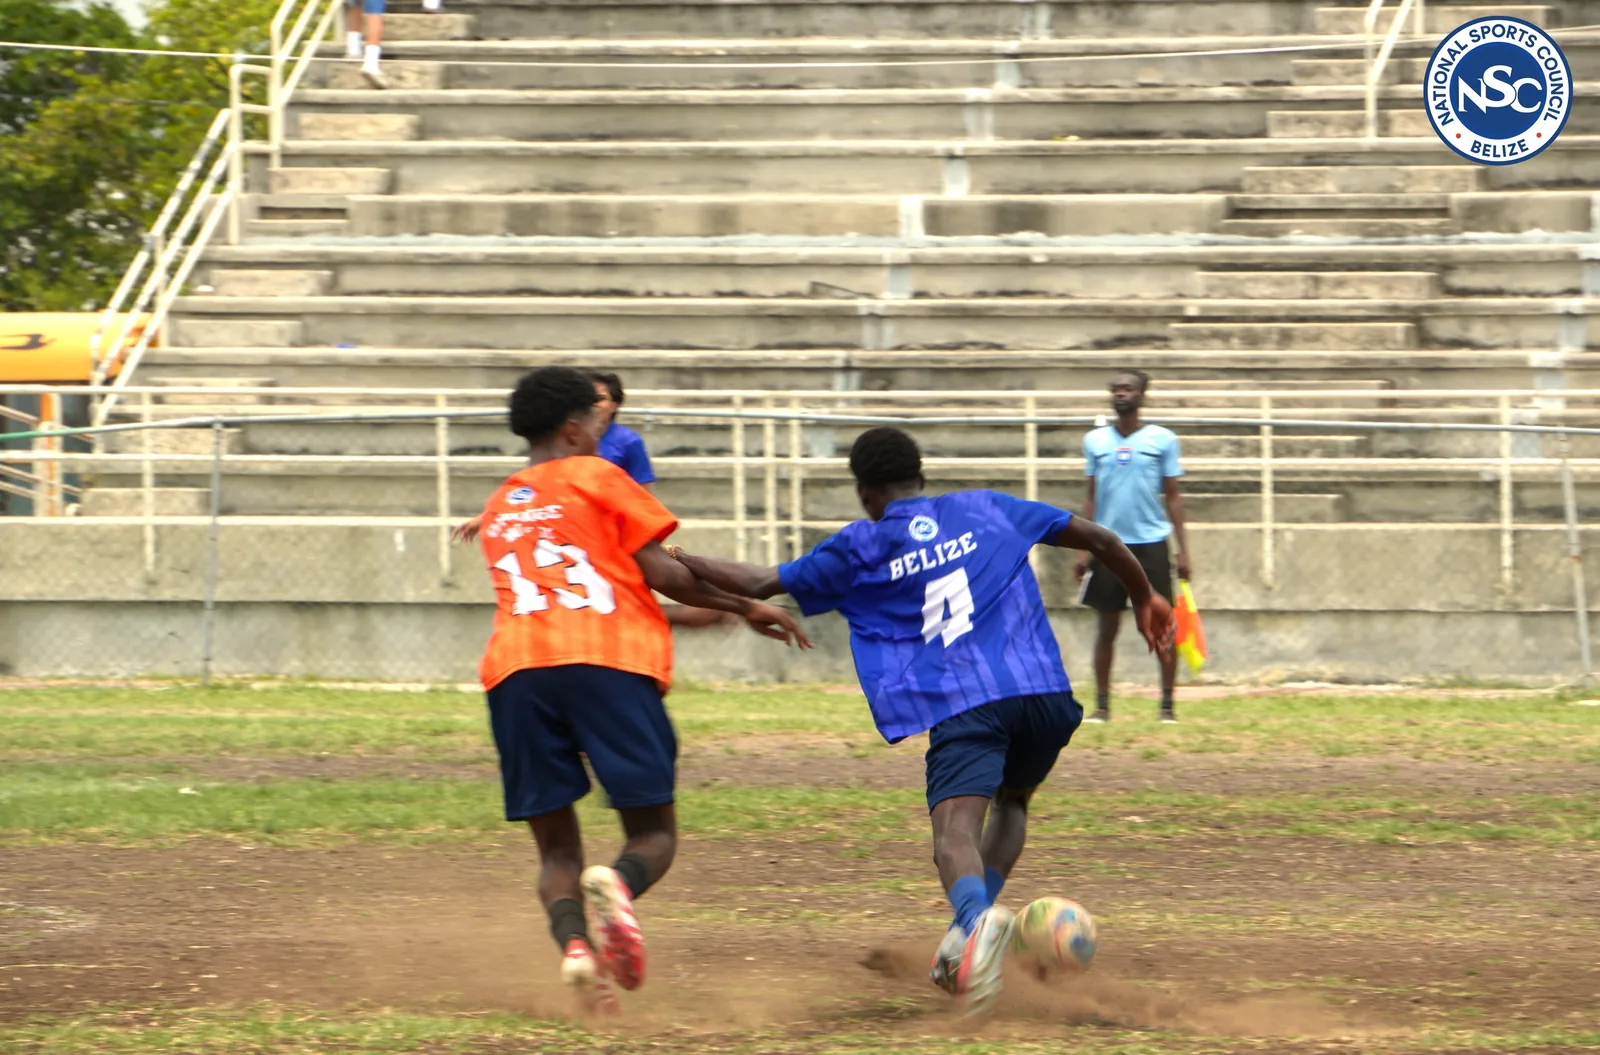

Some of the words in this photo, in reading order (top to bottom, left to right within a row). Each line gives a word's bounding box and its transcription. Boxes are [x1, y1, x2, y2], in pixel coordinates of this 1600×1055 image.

[493, 538, 617, 617] 13
[889, 531, 978, 582] BELIZE
[920, 566, 975, 649] 4
